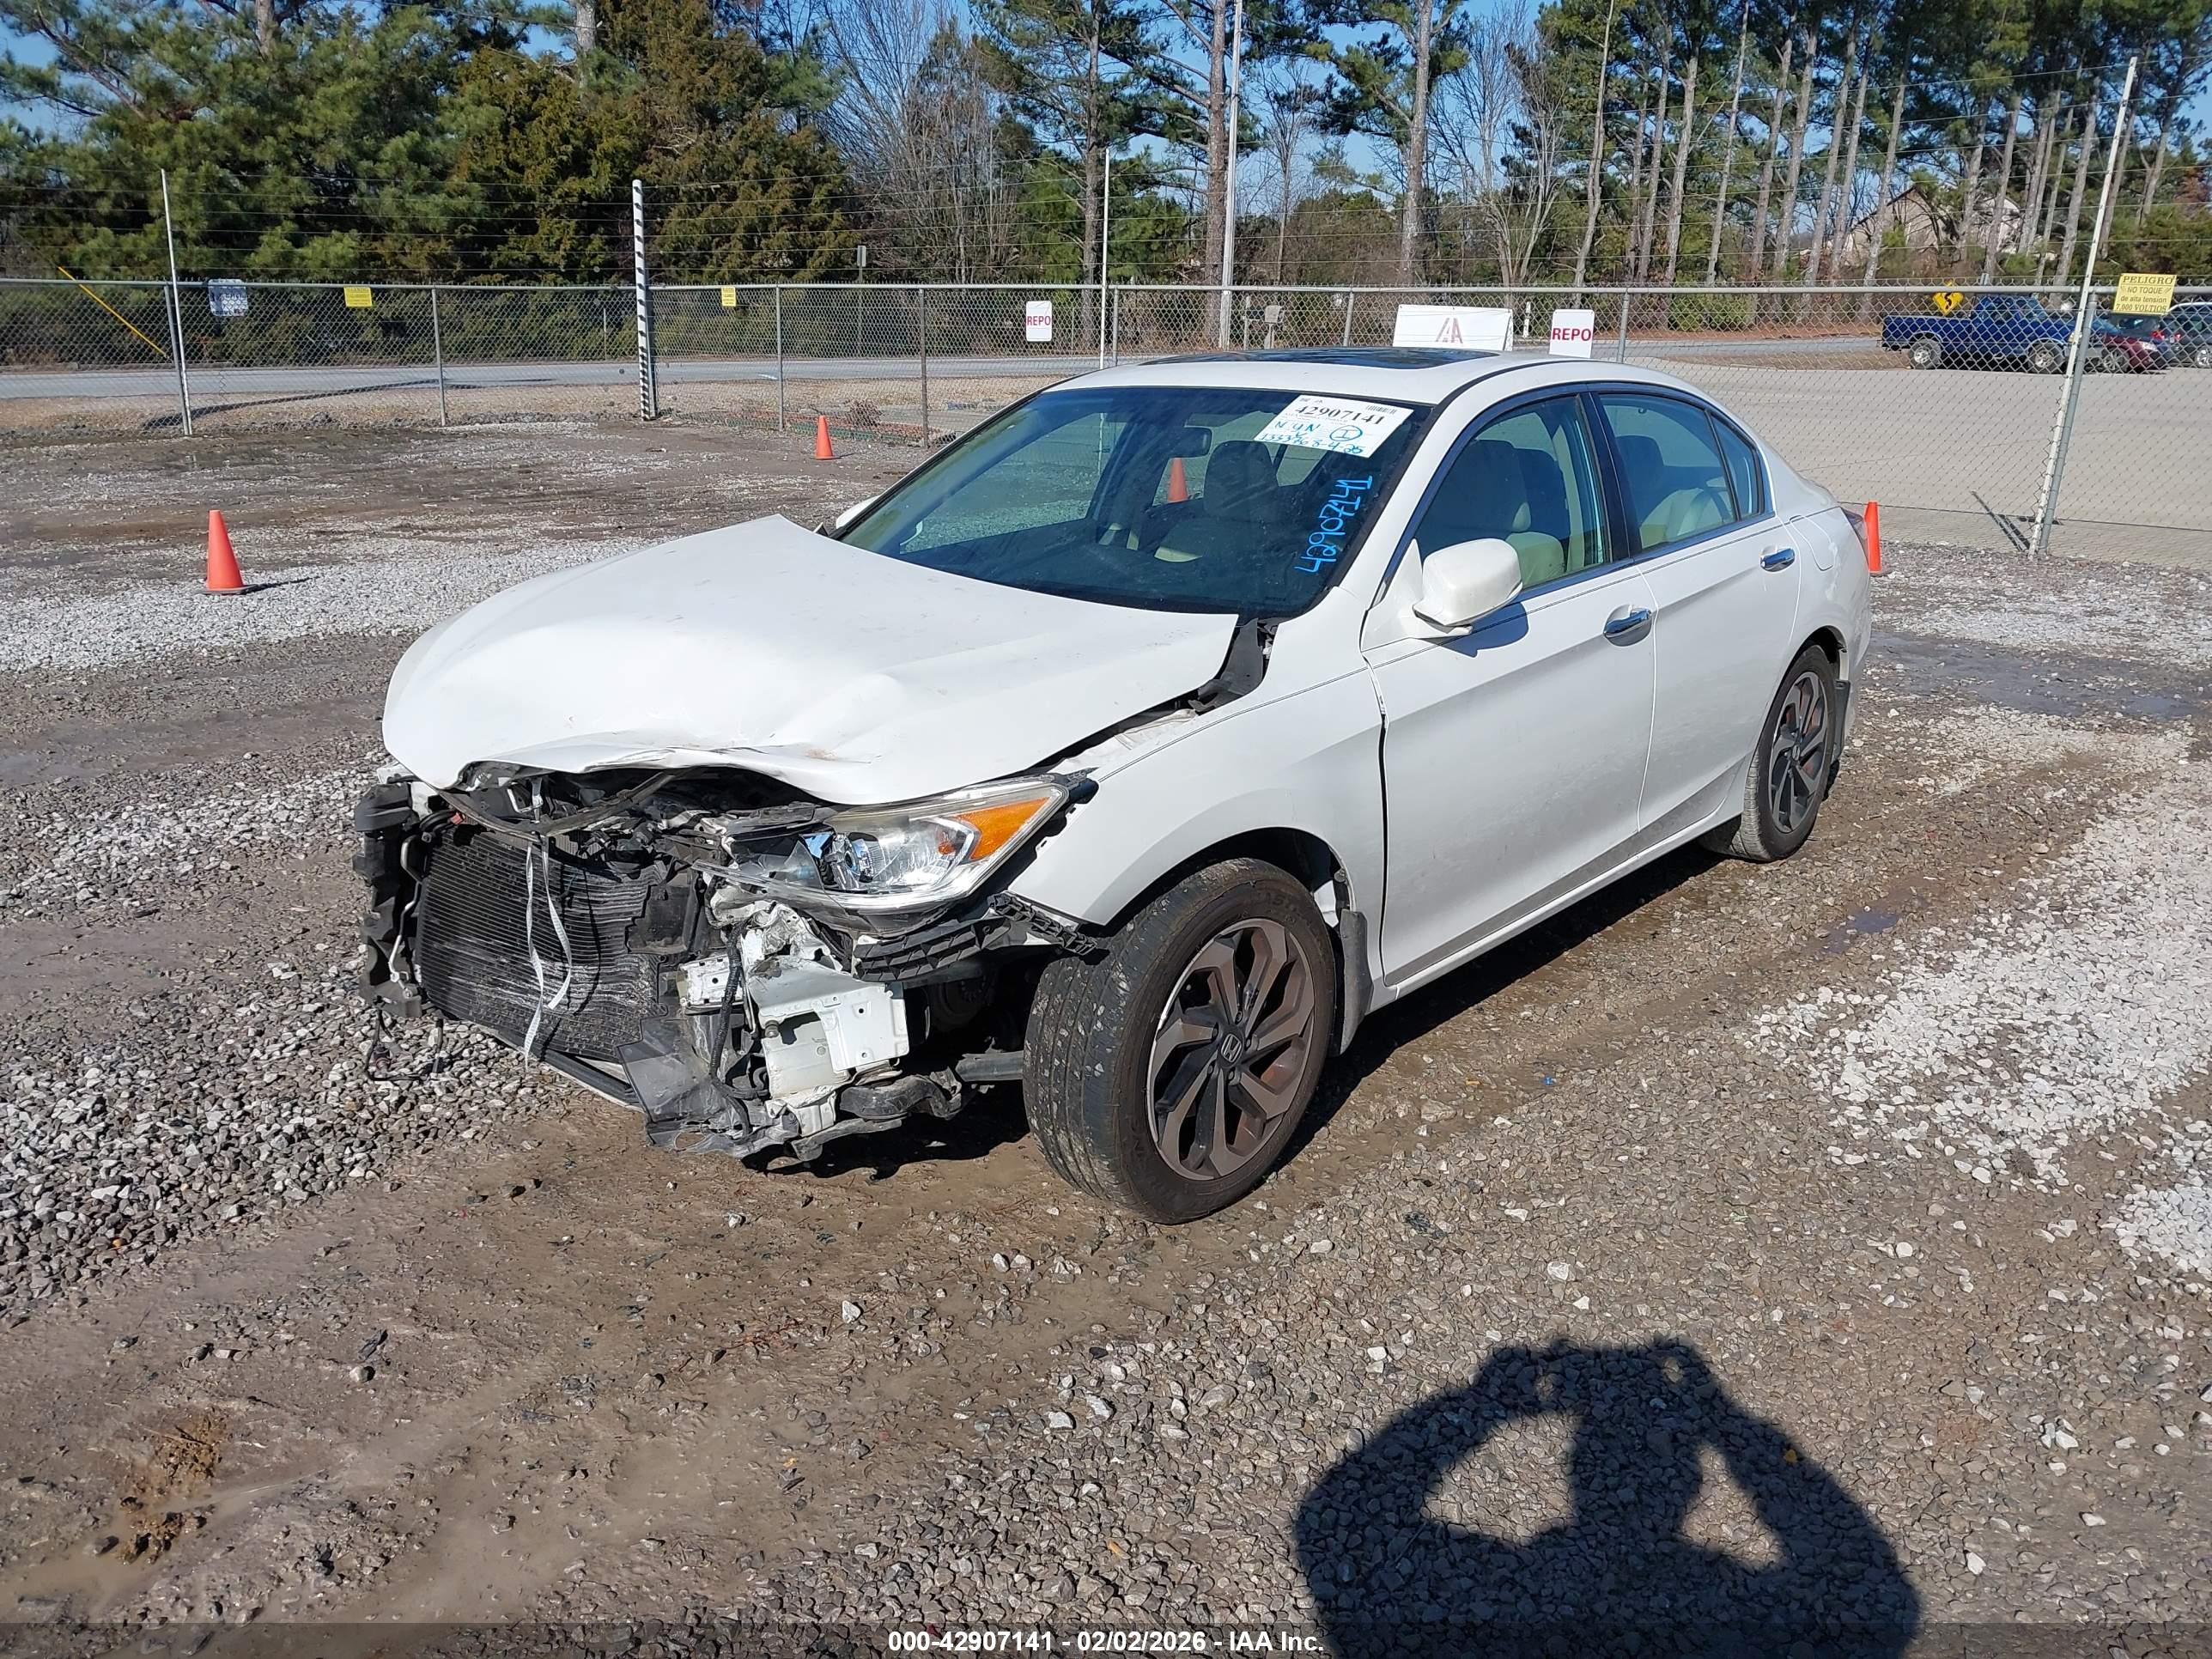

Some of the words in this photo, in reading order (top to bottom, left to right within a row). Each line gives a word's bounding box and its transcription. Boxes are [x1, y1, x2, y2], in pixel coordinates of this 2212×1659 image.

[2122, 276, 2173, 285] PELIGRO
[2142, 295, 2167, 303] tension
[1026, 315, 1051, 326] REPO
[1552, 327, 1592, 342] REPO
[1295, 405, 1385, 425] 42907141
[1294, 475, 1373, 574] 42907141
